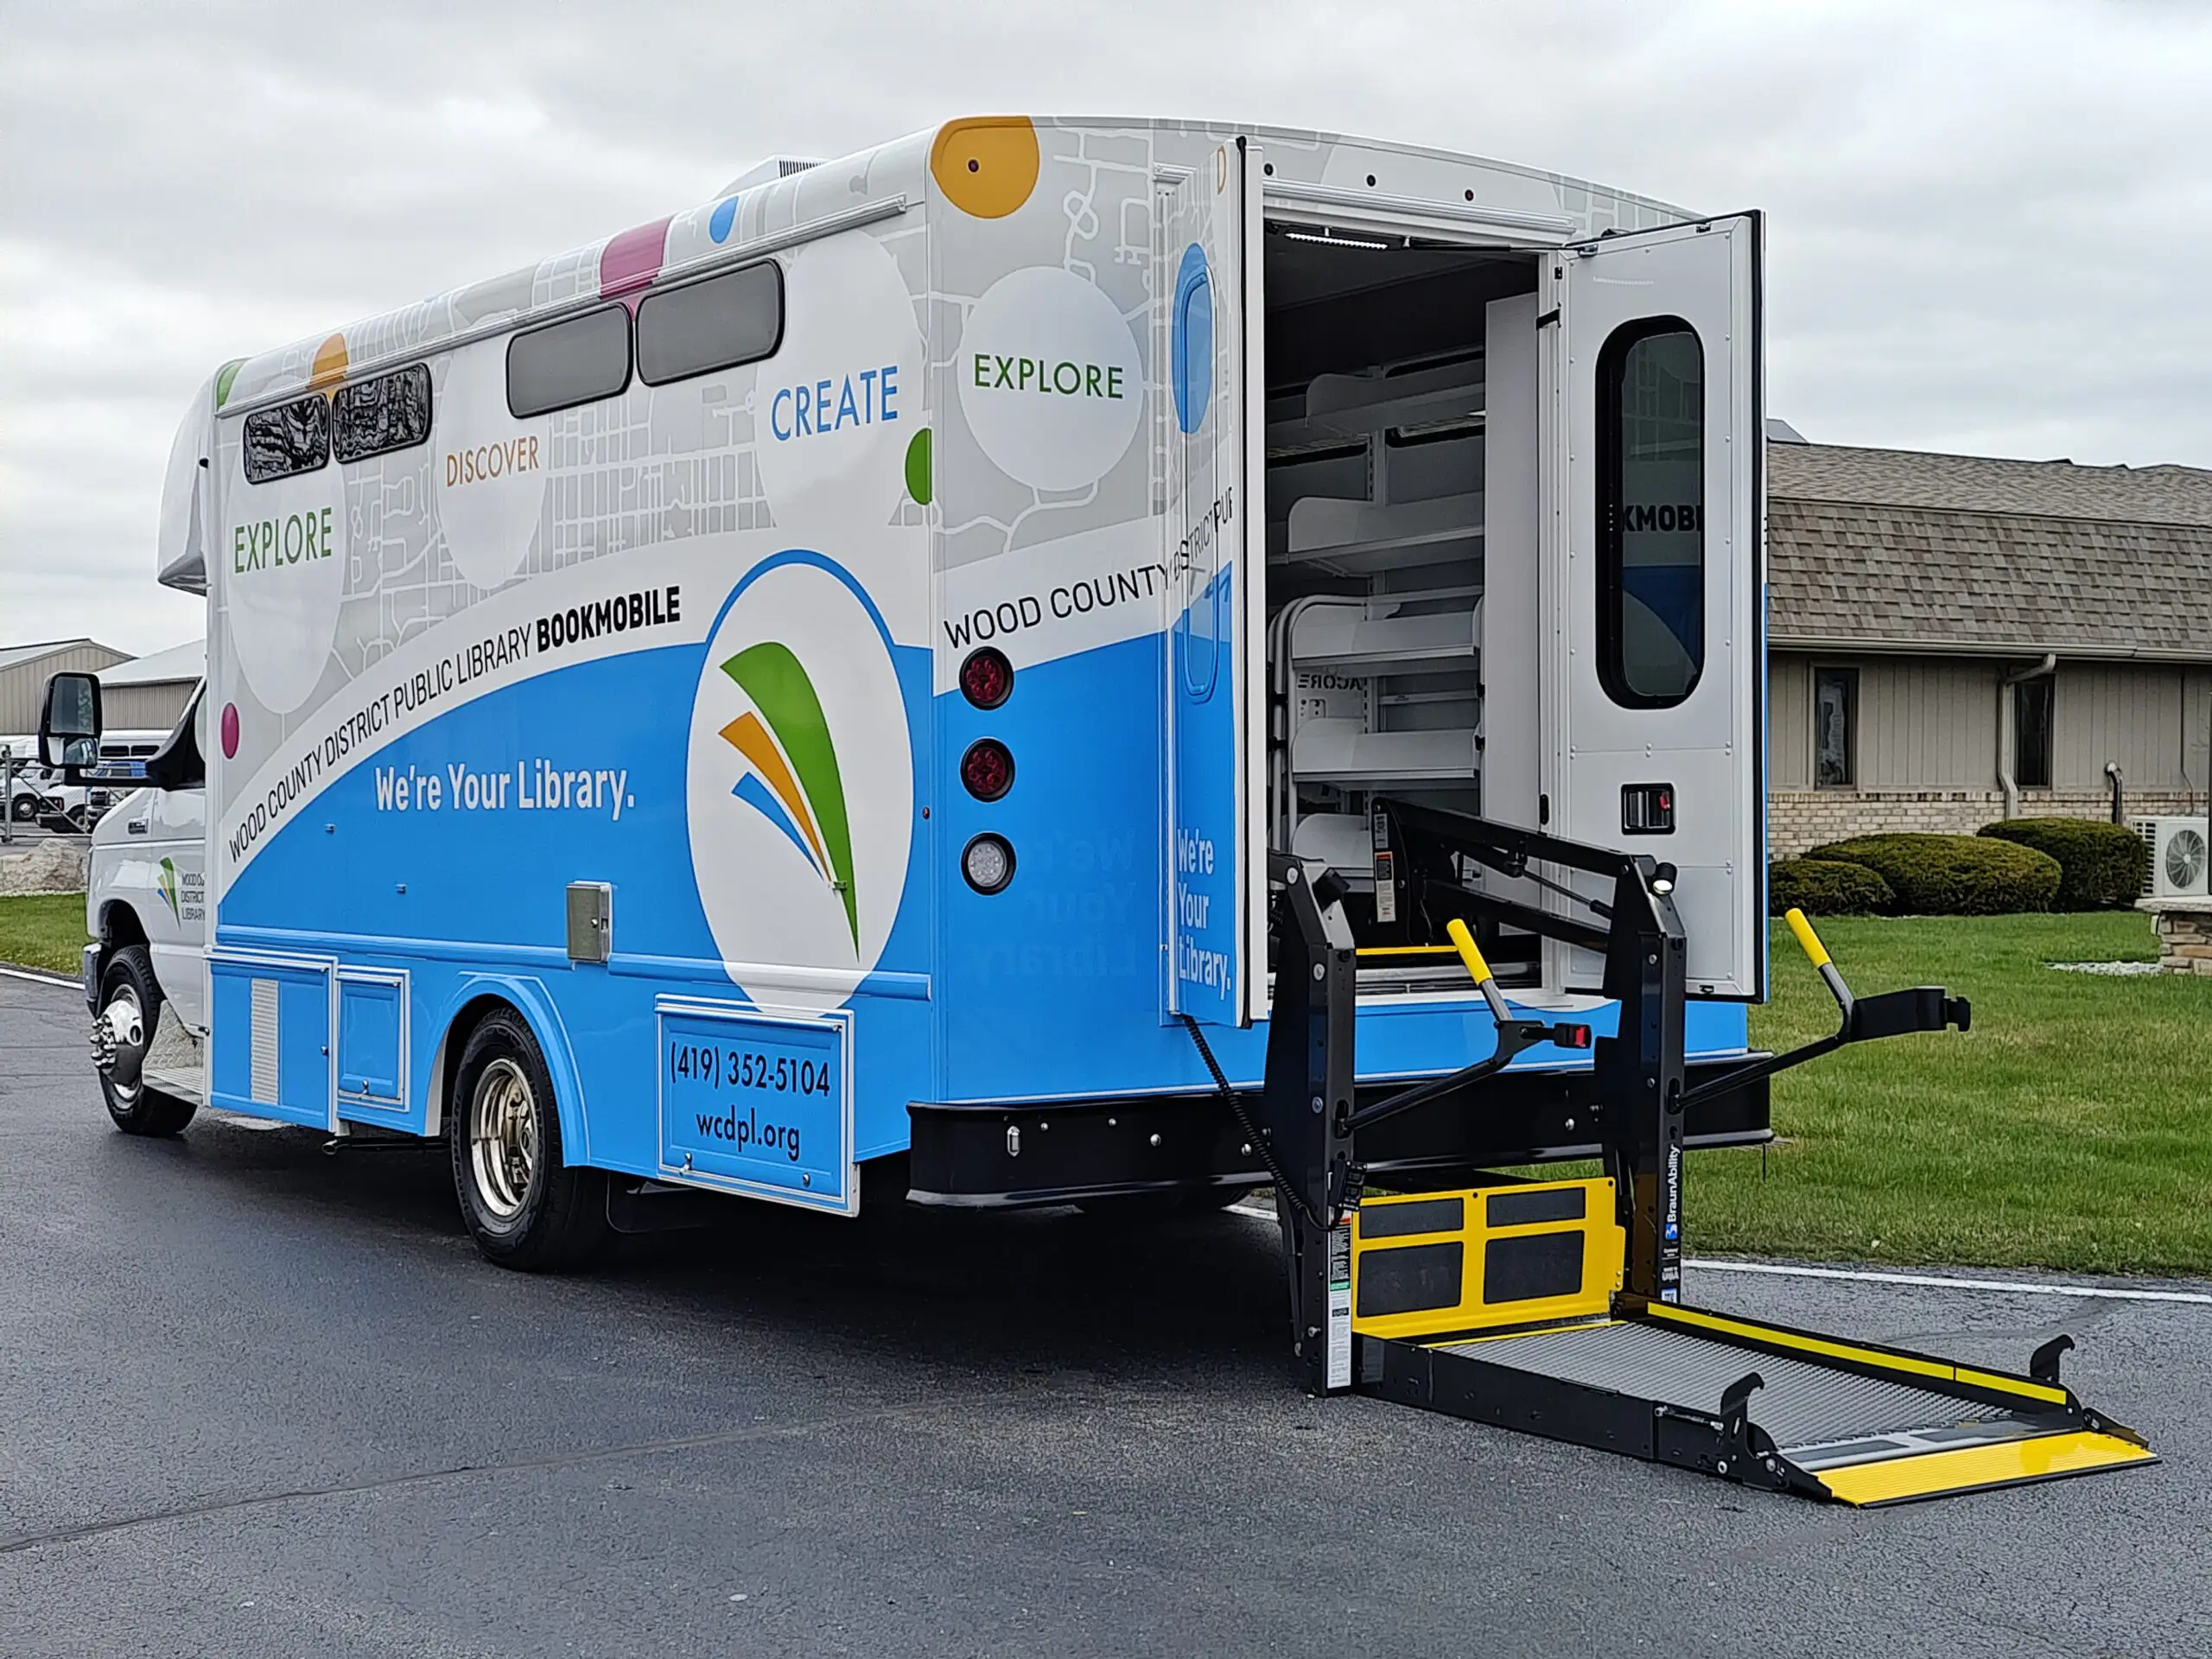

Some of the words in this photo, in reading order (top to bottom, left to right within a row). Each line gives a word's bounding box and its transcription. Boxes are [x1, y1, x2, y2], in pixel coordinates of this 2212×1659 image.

[772, 365, 899, 442] CREATE
[974, 353, 1124, 399] EXPLORE
[447, 435, 539, 487] DISCOVER
[234, 507, 333, 574] EXPLORE
[944, 596, 1042, 649] WOOD
[1051, 563, 1169, 619] COUNTY
[229, 803, 267, 862] WOOD
[268, 745, 321, 818] COUNTY
[325, 695, 390, 766] DISTRICT
[394, 659, 453, 719] PUBLIC
[457, 623, 531, 684] LIBRARY
[536, 585, 680, 652] BOOKMOBILE
[375, 764, 442, 810] We're
[447, 763, 511, 810] Your
[518, 758, 635, 821] Library.
[1177, 828, 1214, 874] We're
[1178, 882, 1210, 929] Your
[1179, 934, 1231, 1001] Library.
[671, 1041, 719, 1089] (419)
[728, 1052, 830, 1096] 352-5104
[696, 1104, 800, 1162] wcdpl.org
[1667, 1144, 1681, 1223] BraunAbility
